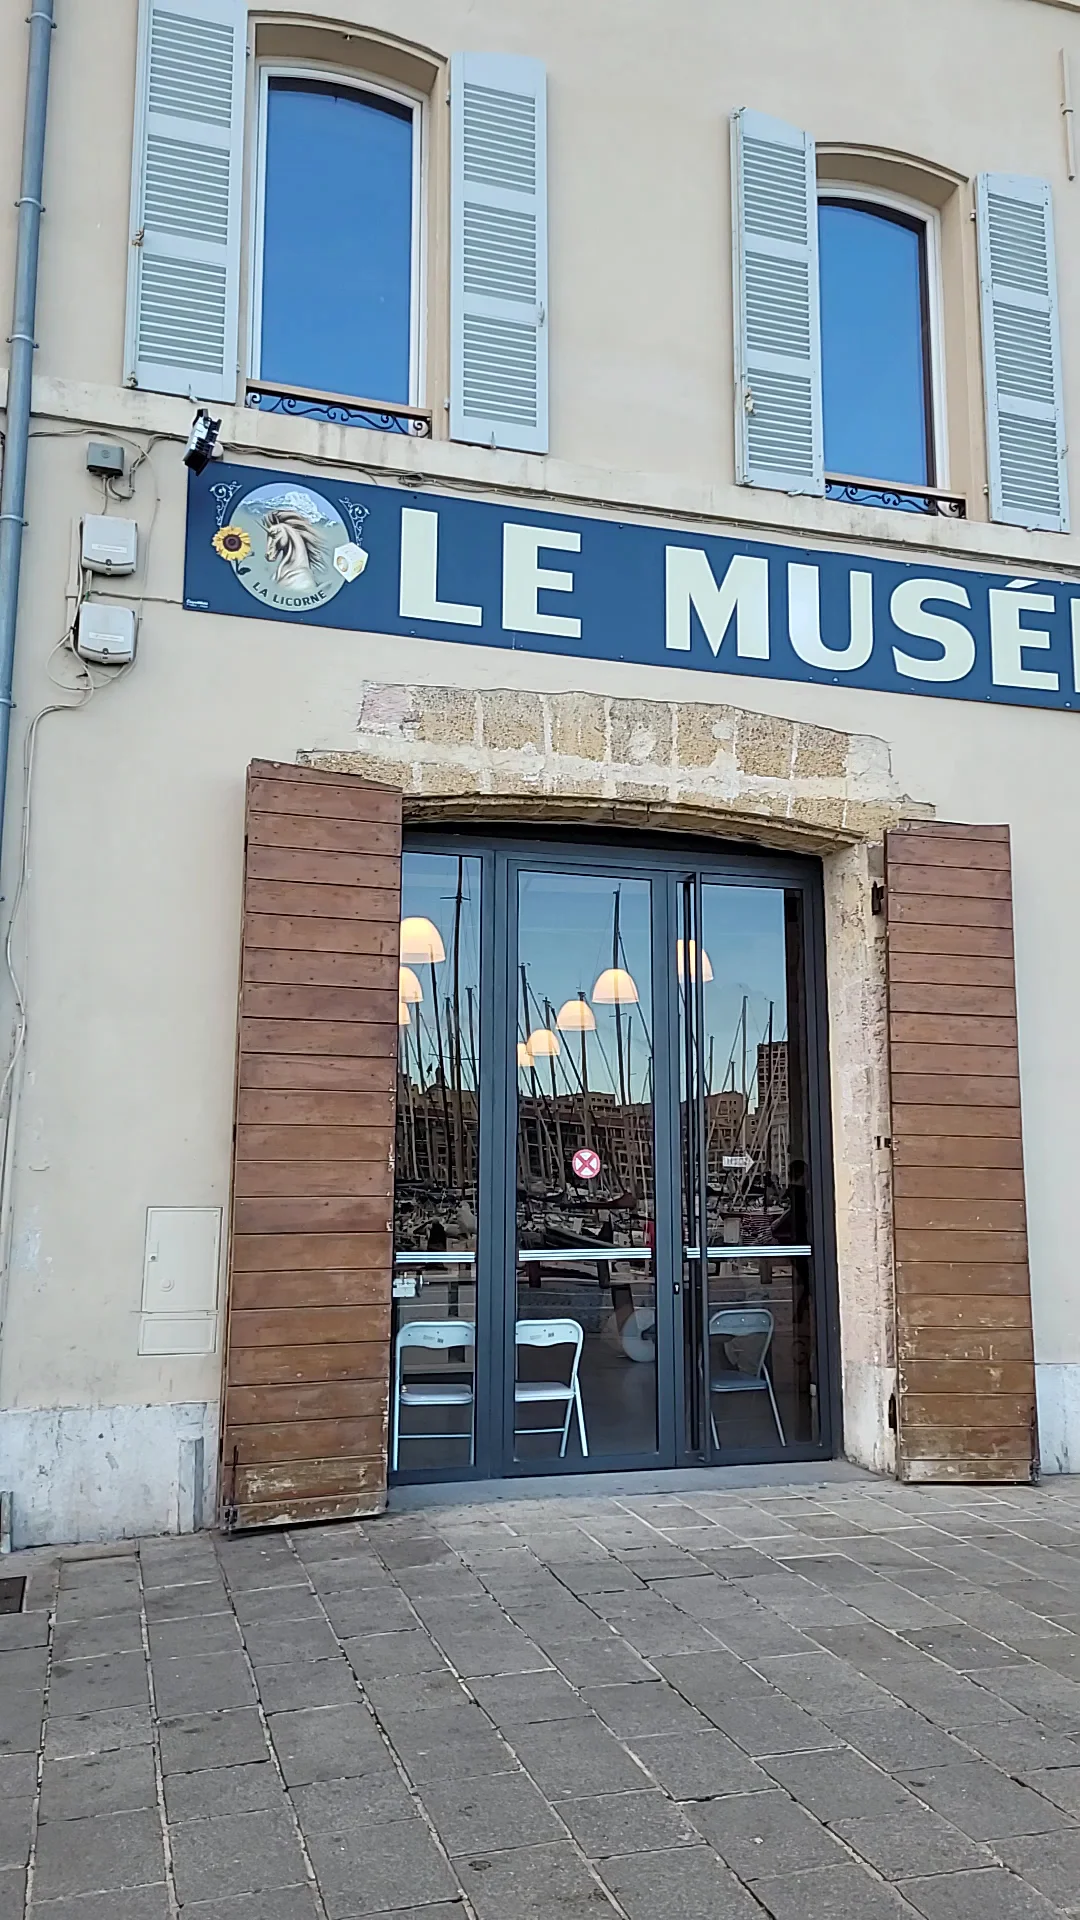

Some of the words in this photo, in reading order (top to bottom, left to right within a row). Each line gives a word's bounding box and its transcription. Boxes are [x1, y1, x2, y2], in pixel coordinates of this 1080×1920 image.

[252, 581, 269, 598] LA
[272, 589, 328, 607] LICORNE
[399, 507, 582, 639] LE
[665, 545, 1080, 693] MUSÉ
